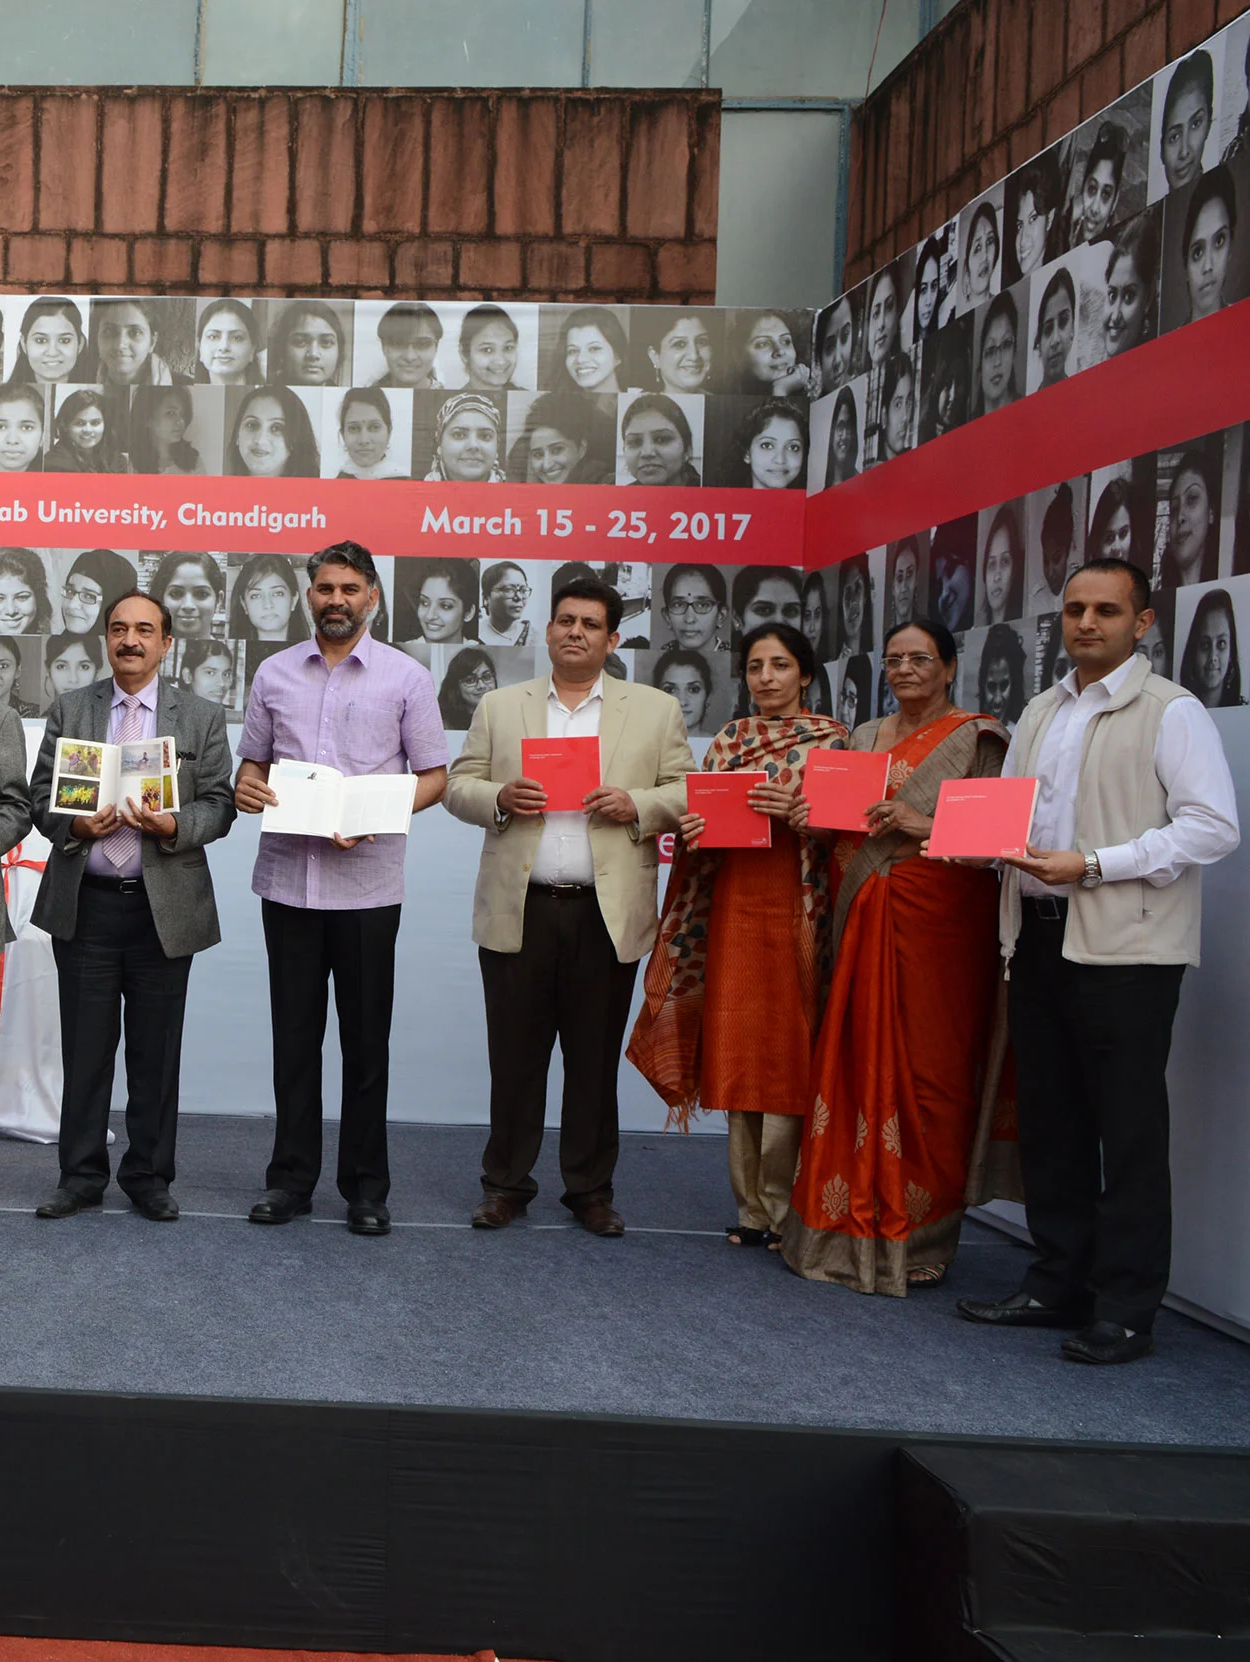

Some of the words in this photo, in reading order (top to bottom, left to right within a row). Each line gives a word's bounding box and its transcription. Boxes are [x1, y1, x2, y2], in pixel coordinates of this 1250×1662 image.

[37, 500, 167, 531] University,
[177, 502, 327, 533] Chandigarh
[420, 506, 522, 535] March
[536, 508, 573, 537] 15
[606, 509, 657, 544] 25,
[668, 511, 752, 541] 2017
